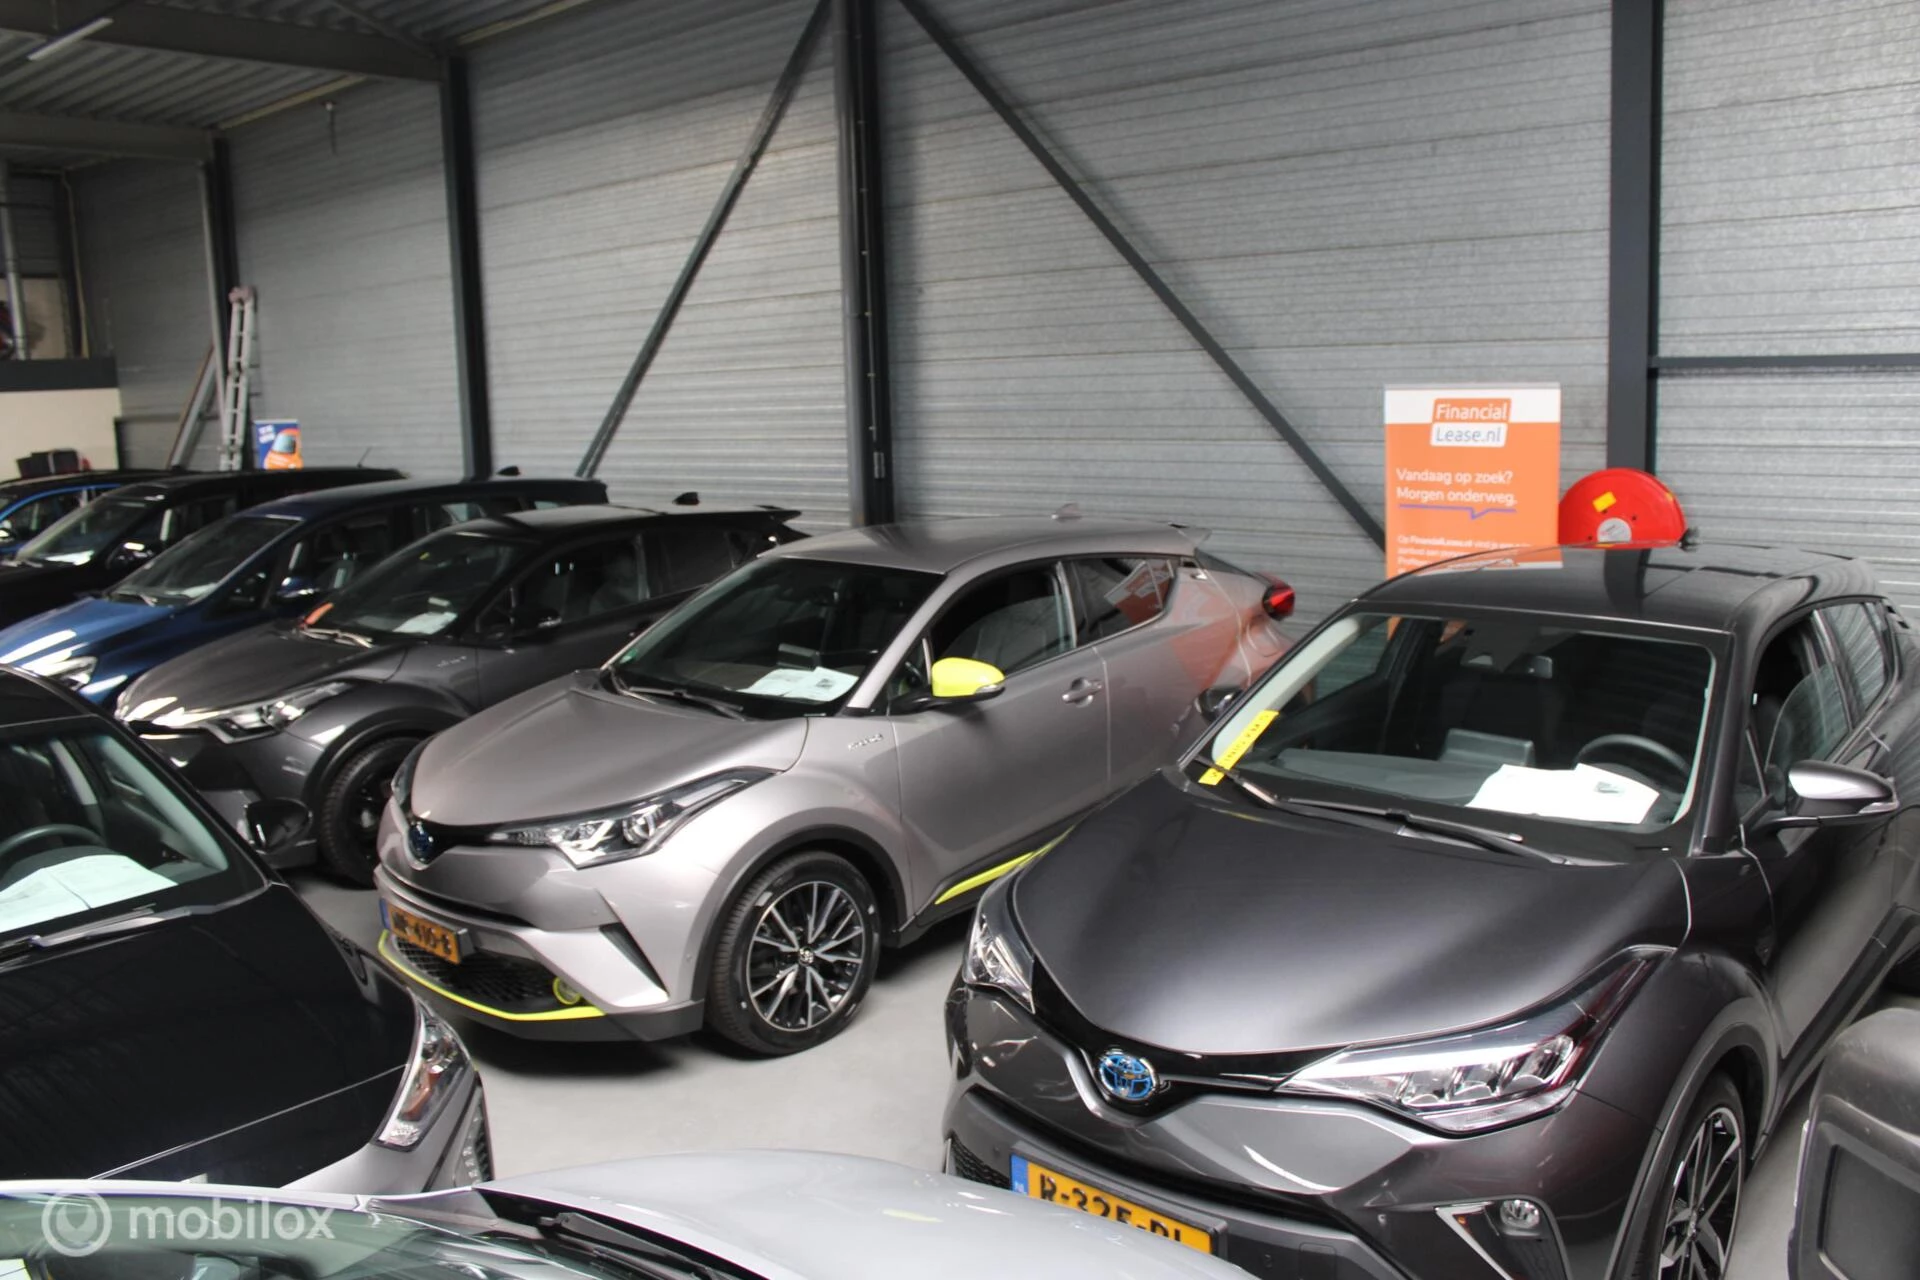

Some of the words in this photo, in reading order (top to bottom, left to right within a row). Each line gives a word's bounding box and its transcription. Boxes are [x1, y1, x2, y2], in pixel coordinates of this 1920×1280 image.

[1435, 402, 1508, 421] Financial
[1435, 426, 1501, 442] Lease.nl
[1396, 467, 1452, 485] Vandaag
[1455, 472, 1472, 486] op
[1475, 471, 1514, 484] zoek?
[1396, 487, 1445, 503] Morgen
[1447, 490, 1518, 507] onderweg.
